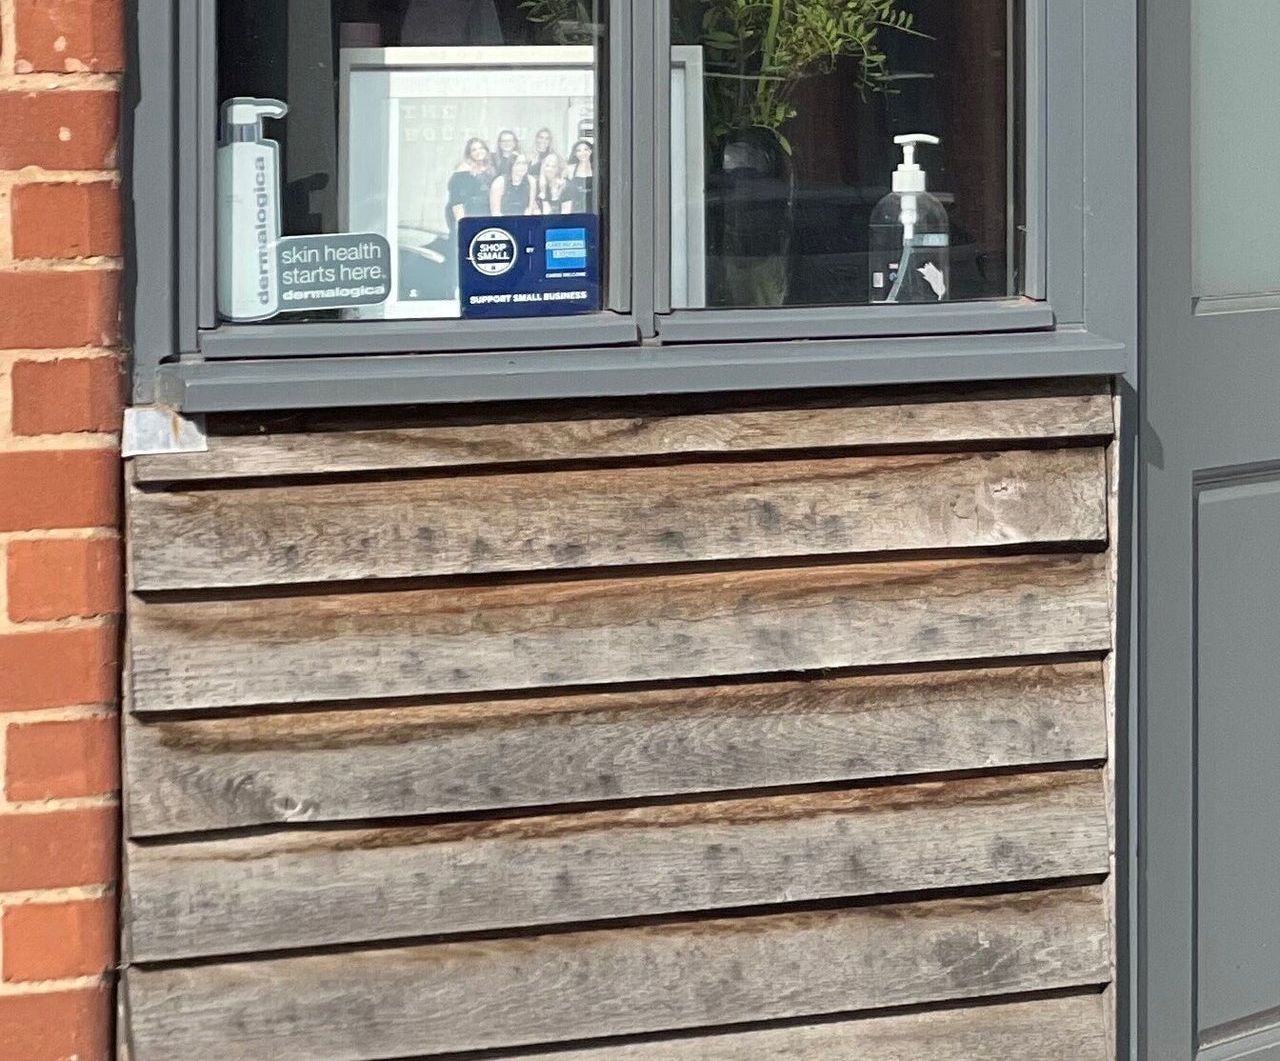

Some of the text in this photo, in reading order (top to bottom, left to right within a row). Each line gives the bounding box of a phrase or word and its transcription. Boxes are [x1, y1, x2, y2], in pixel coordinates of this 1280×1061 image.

[253, 156, 270, 305] dermalogica
[281, 242, 381, 264] skin health
[477, 251, 510, 260] SMALL
[479, 243, 507, 253] SHOP
[282, 266, 336, 285] starts
[282, 284, 385, 301] dermalogica
[470, 291, 588, 305] SUPPORT SMALL BUSINESS
